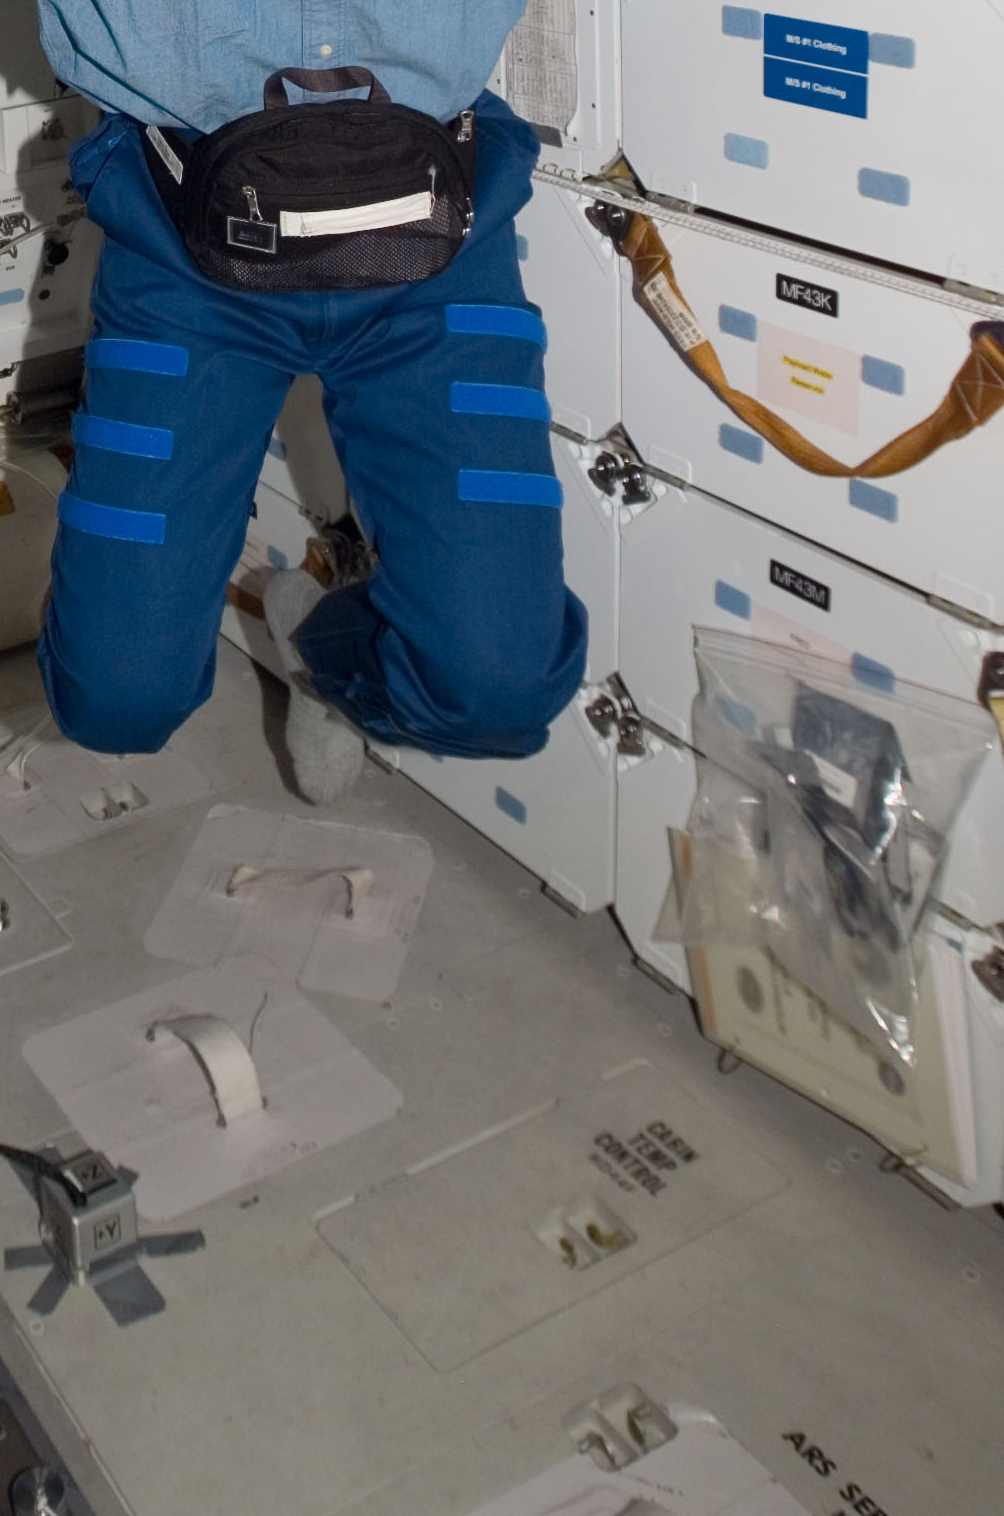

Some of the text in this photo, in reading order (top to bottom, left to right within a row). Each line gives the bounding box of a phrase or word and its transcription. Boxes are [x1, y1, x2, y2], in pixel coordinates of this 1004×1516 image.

[813, 39, 847, 56] Clothing
[812, 82, 847, 101] Clothing
[780, 280, 833, 311] MF43K
[774, 565, 826, 605] MF43M
[594, 1132, 668, 1198] CONTROL
[781, 1432, 837, 1478] ARS
